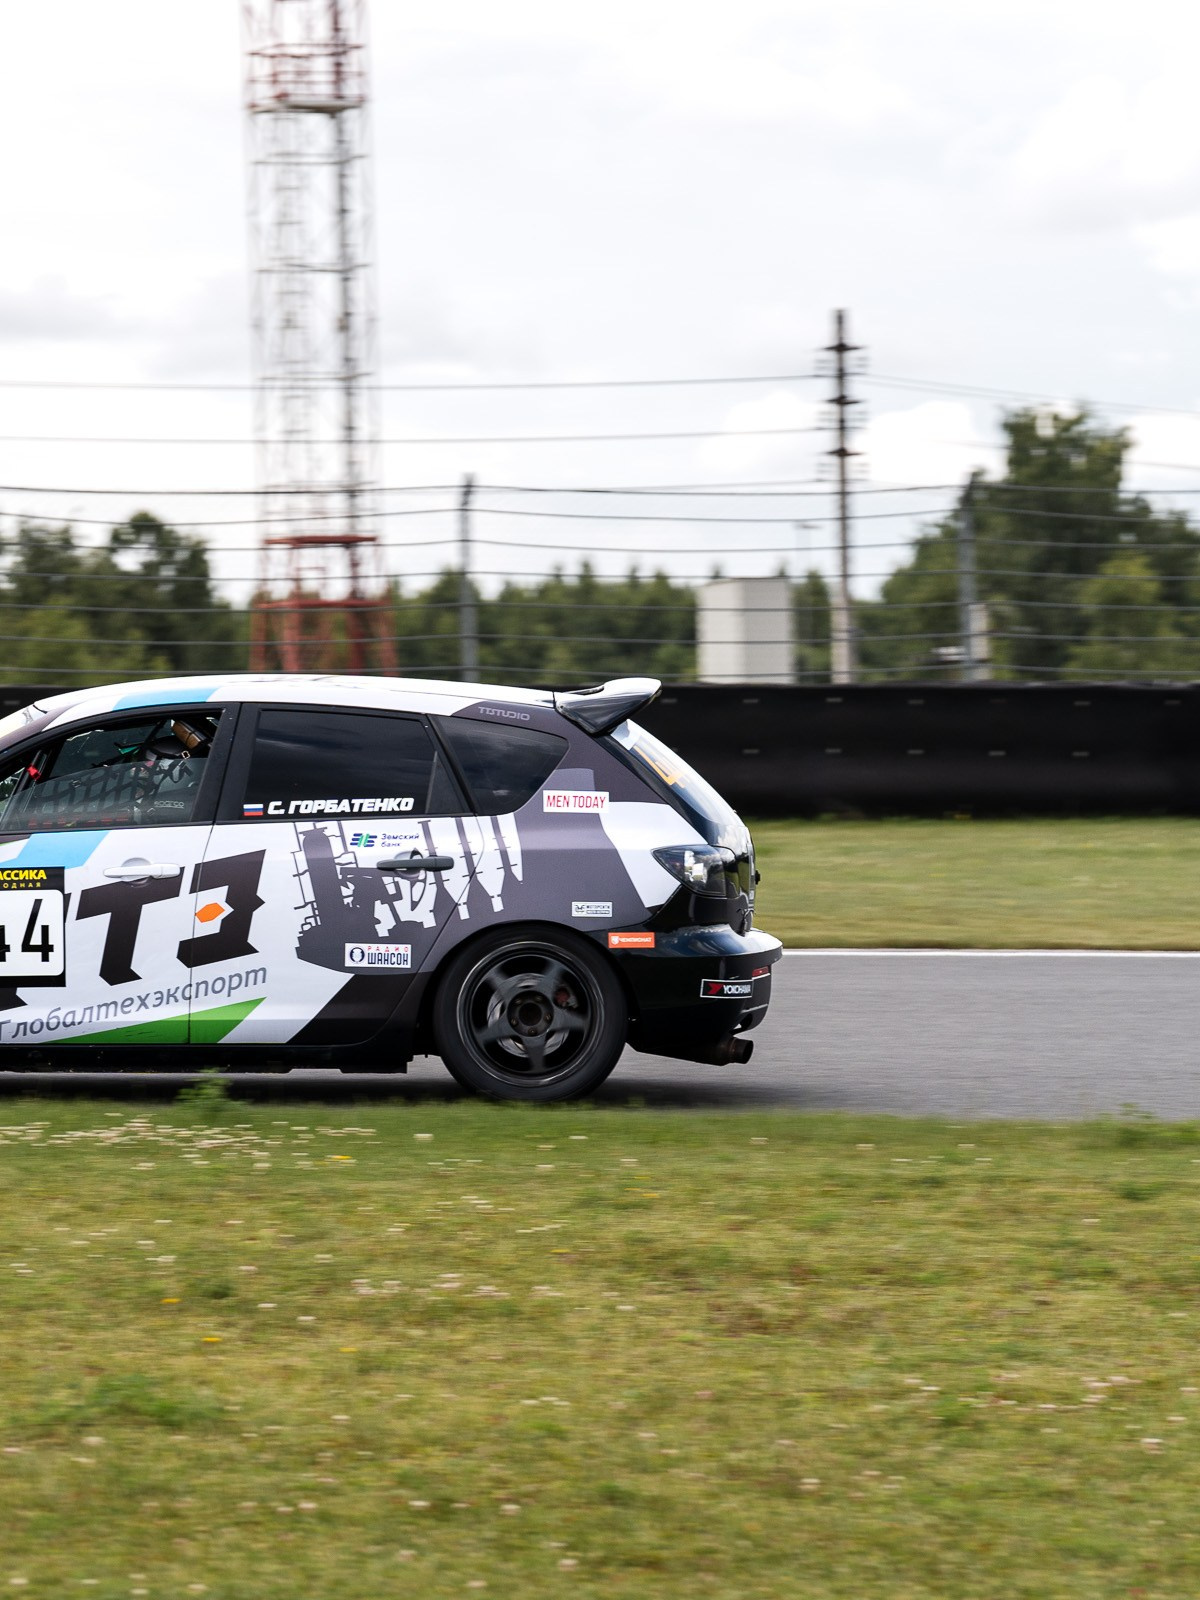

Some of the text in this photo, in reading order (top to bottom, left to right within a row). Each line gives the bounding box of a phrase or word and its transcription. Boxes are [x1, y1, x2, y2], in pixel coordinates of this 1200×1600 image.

[267, 797, 415, 815] С. ГОРБАТЕНКО
[546, 795, 606, 809] MEN TODAY
[380, 833, 420, 841] Земский
[367, 952, 409, 966] ШАНСОН
